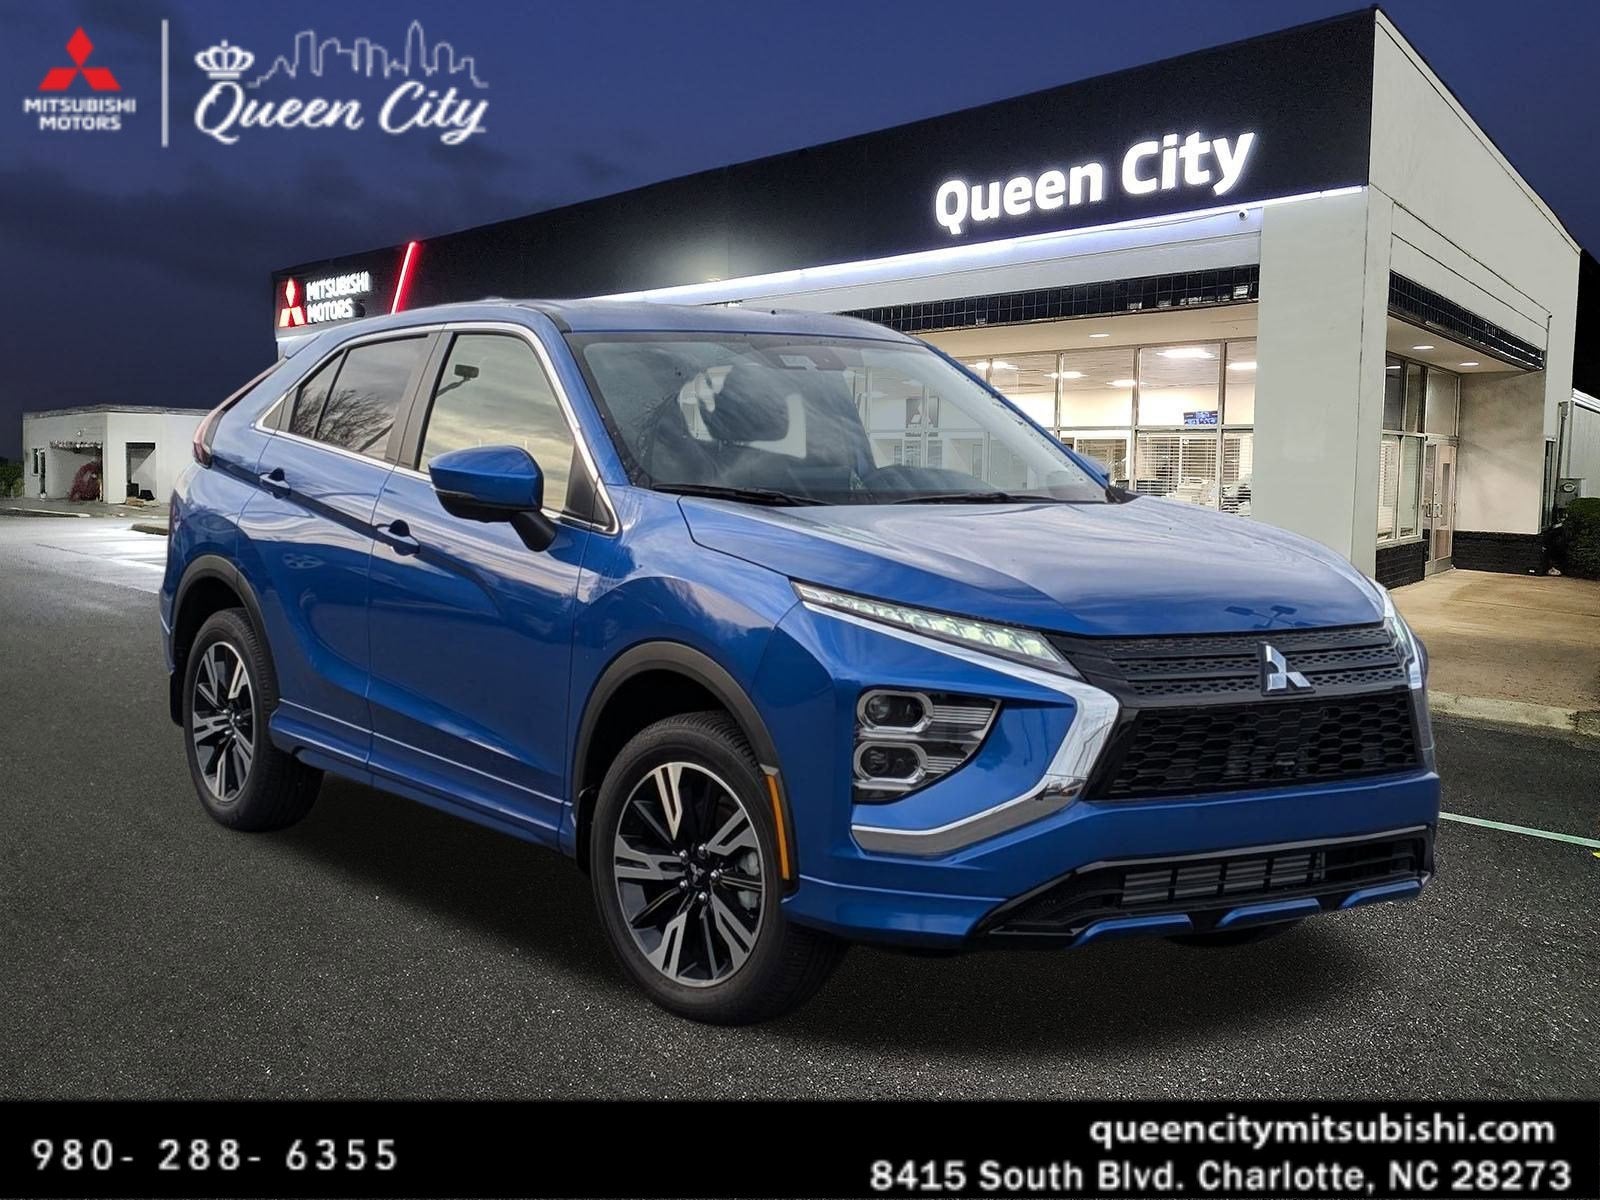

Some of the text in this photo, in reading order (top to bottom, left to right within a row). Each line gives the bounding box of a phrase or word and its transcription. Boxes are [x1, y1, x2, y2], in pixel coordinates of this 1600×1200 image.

[935, 131, 1256, 235] Queen City
[305, 270, 371, 302] MITSUBISHI
[306, 297, 354, 324] MOTORS
